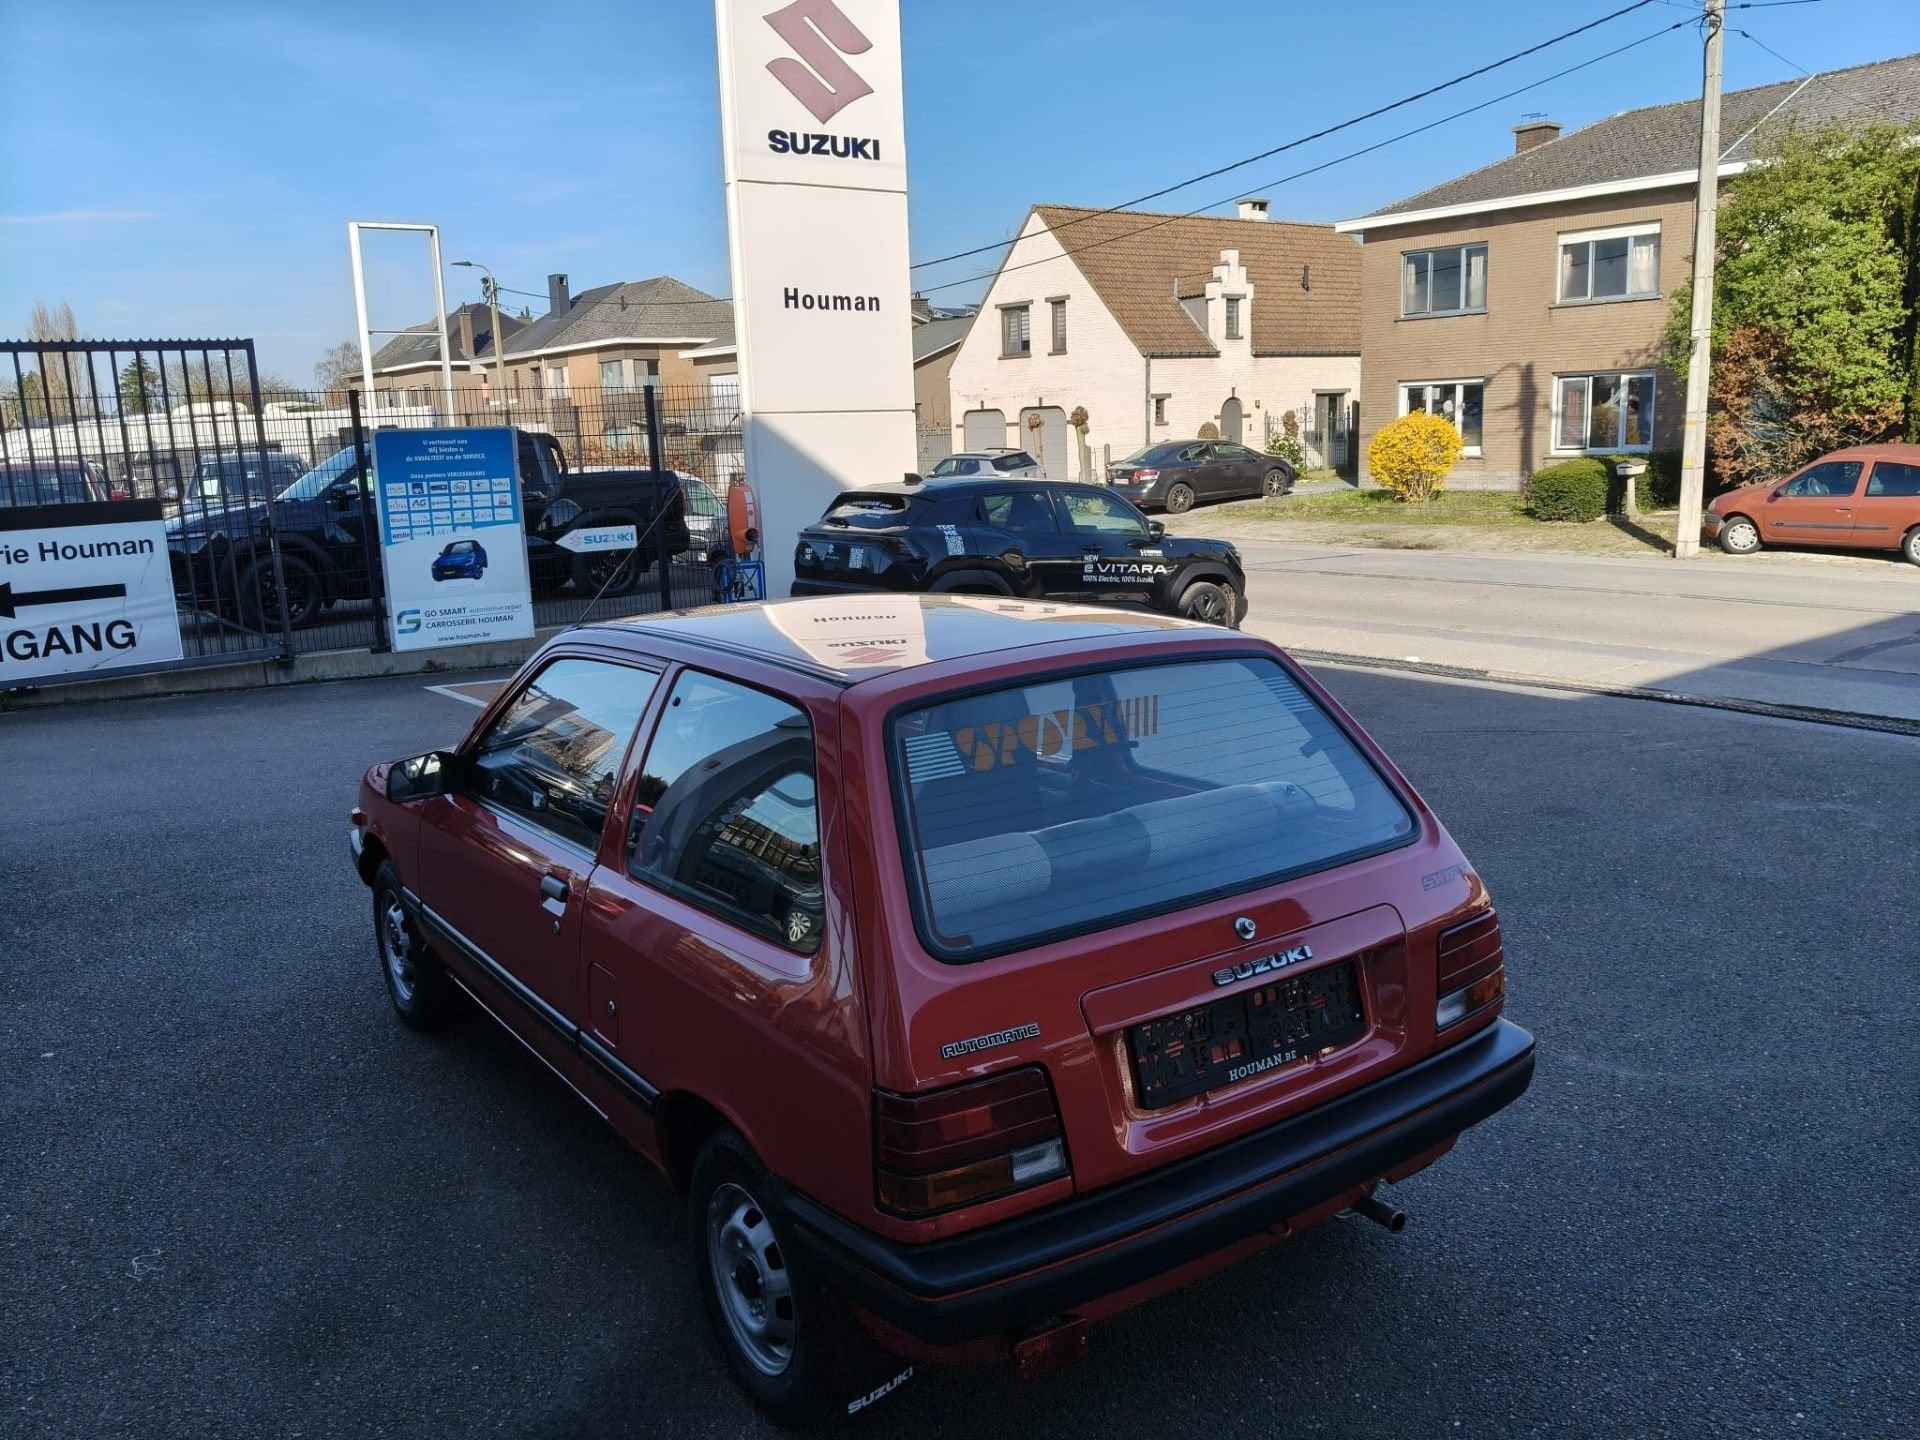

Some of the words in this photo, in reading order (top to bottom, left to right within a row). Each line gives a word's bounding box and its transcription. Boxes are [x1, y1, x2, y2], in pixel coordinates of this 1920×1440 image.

[768, 129, 880, 160] SUZUKI
[784, 287, 880, 311] Houman
[0, 544, 29, 564] ie
[38, 538, 154, 562] Houman
[583, 532, 634, 544] SUZUKI
[1097, 564, 1167, 574] VITARA
[426, 618, 476, 629] CARROSSERIE
[478, 615, 513, 625] HOUMAN
[440, 607, 467, 616] SMART
[470, 606, 503, 614] automotive
[504, 604, 522, 612] repair
[0, 620, 137, 662] GANG
[438, 631, 490, 642] www.houman.be
[1213, 945, 1313, 986] SUZUKI
[942, 1023, 1040, 1059] AUTOMATIC
[1229, 1050, 1297, 1081] HOUMAN.BE
[848, 1366, 913, 1415] SUZUKI
